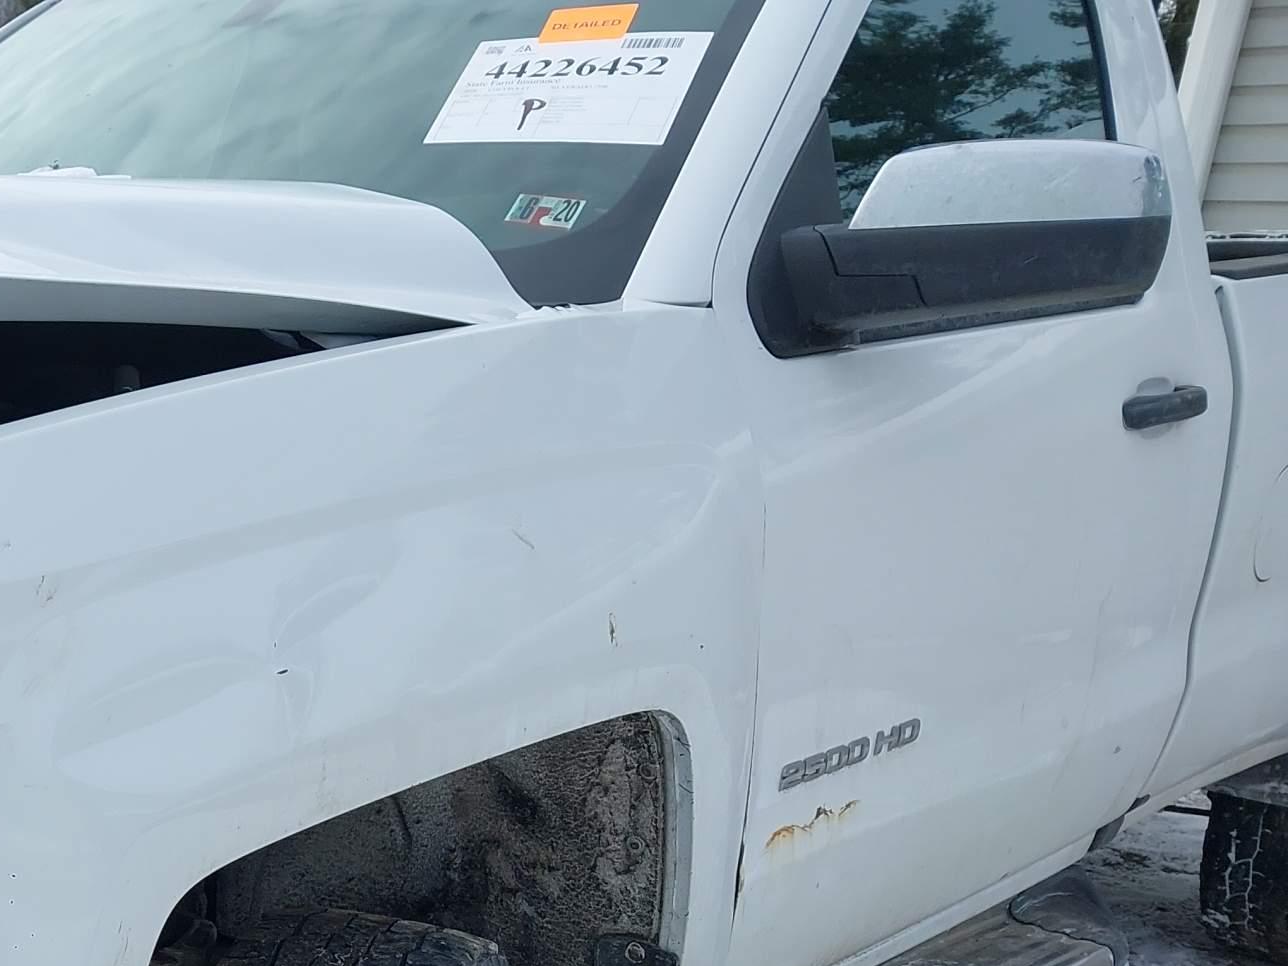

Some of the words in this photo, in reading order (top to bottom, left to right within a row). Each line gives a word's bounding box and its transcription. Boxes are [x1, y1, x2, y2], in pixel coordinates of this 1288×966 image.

[552, 18, 622, 30] DETAILED
[485, 56, 669, 80] 44226452
[517, 98, 547, 131] P
[553, 199, 581, 223] 20
[778, 736, 870, 792] 2500
[873, 718, 921, 756] HD
